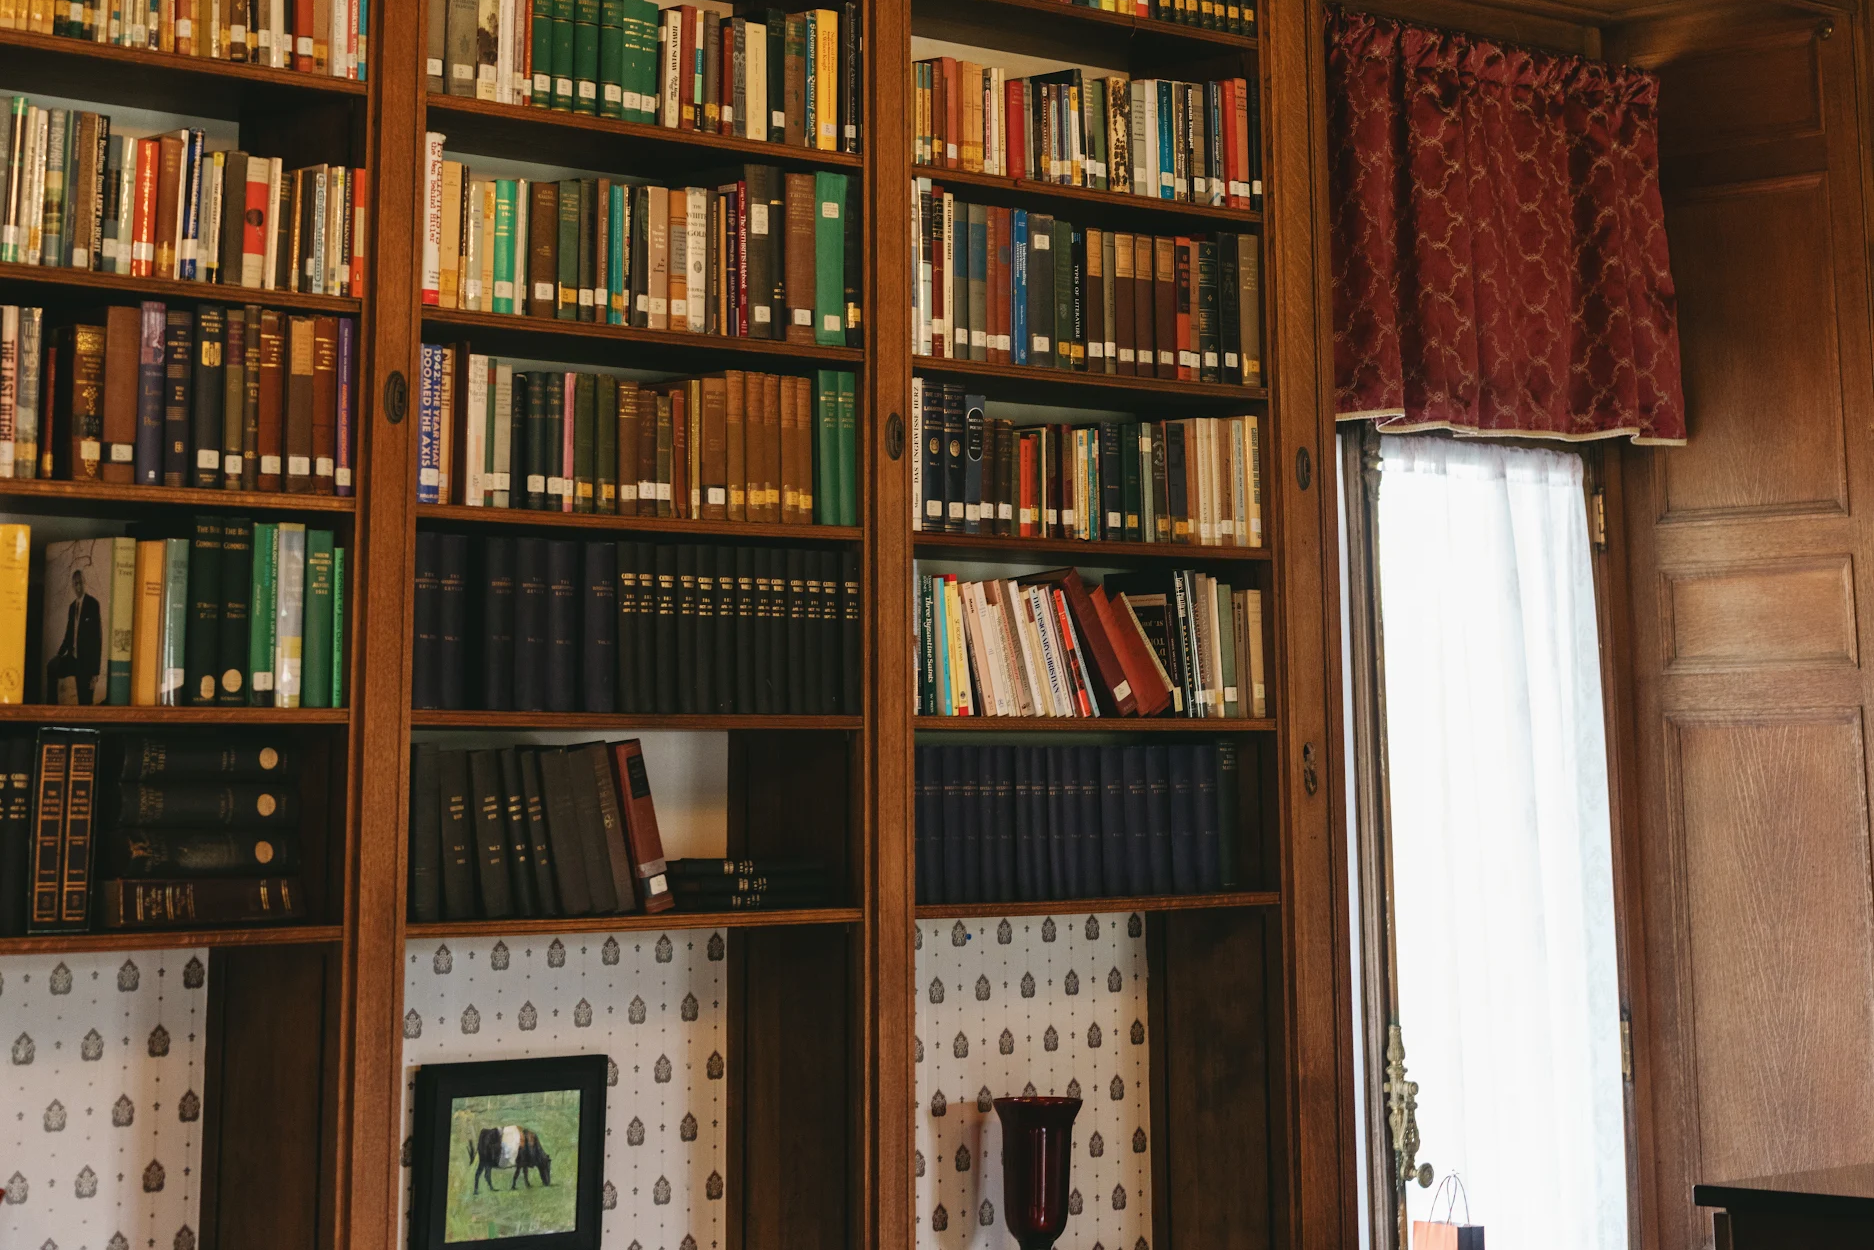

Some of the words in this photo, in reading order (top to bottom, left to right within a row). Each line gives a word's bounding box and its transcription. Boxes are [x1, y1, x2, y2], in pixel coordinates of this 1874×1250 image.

[807, 75, 816, 100] Queen
[808, 100, 815, 111] of
[97, 139, 107, 174] Readings
[93, 226, 101, 254] RIGHT
[1, 339, 14, 362] THE
[433, 349, 441, 381] 1942:
[0, 367, 14, 398] LAST
[422, 348, 433, 406] DOOMED
[433, 384, 441, 407] THE
[0, 403, 13, 441] DITCH
[421, 408, 432, 433] THE
[432, 409, 440, 440] YEAR
[420, 435, 431, 467] AXIS
[432, 442, 440, 468] THAT
[925, 596, 933, 618] Three
[923, 618, 932, 659] Byzantine
[1032, 596, 1040, 611] THE
[1036, 612, 1050, 654] VISIONARY
[1045, 652, 1060, 694] CHRISTIAN
